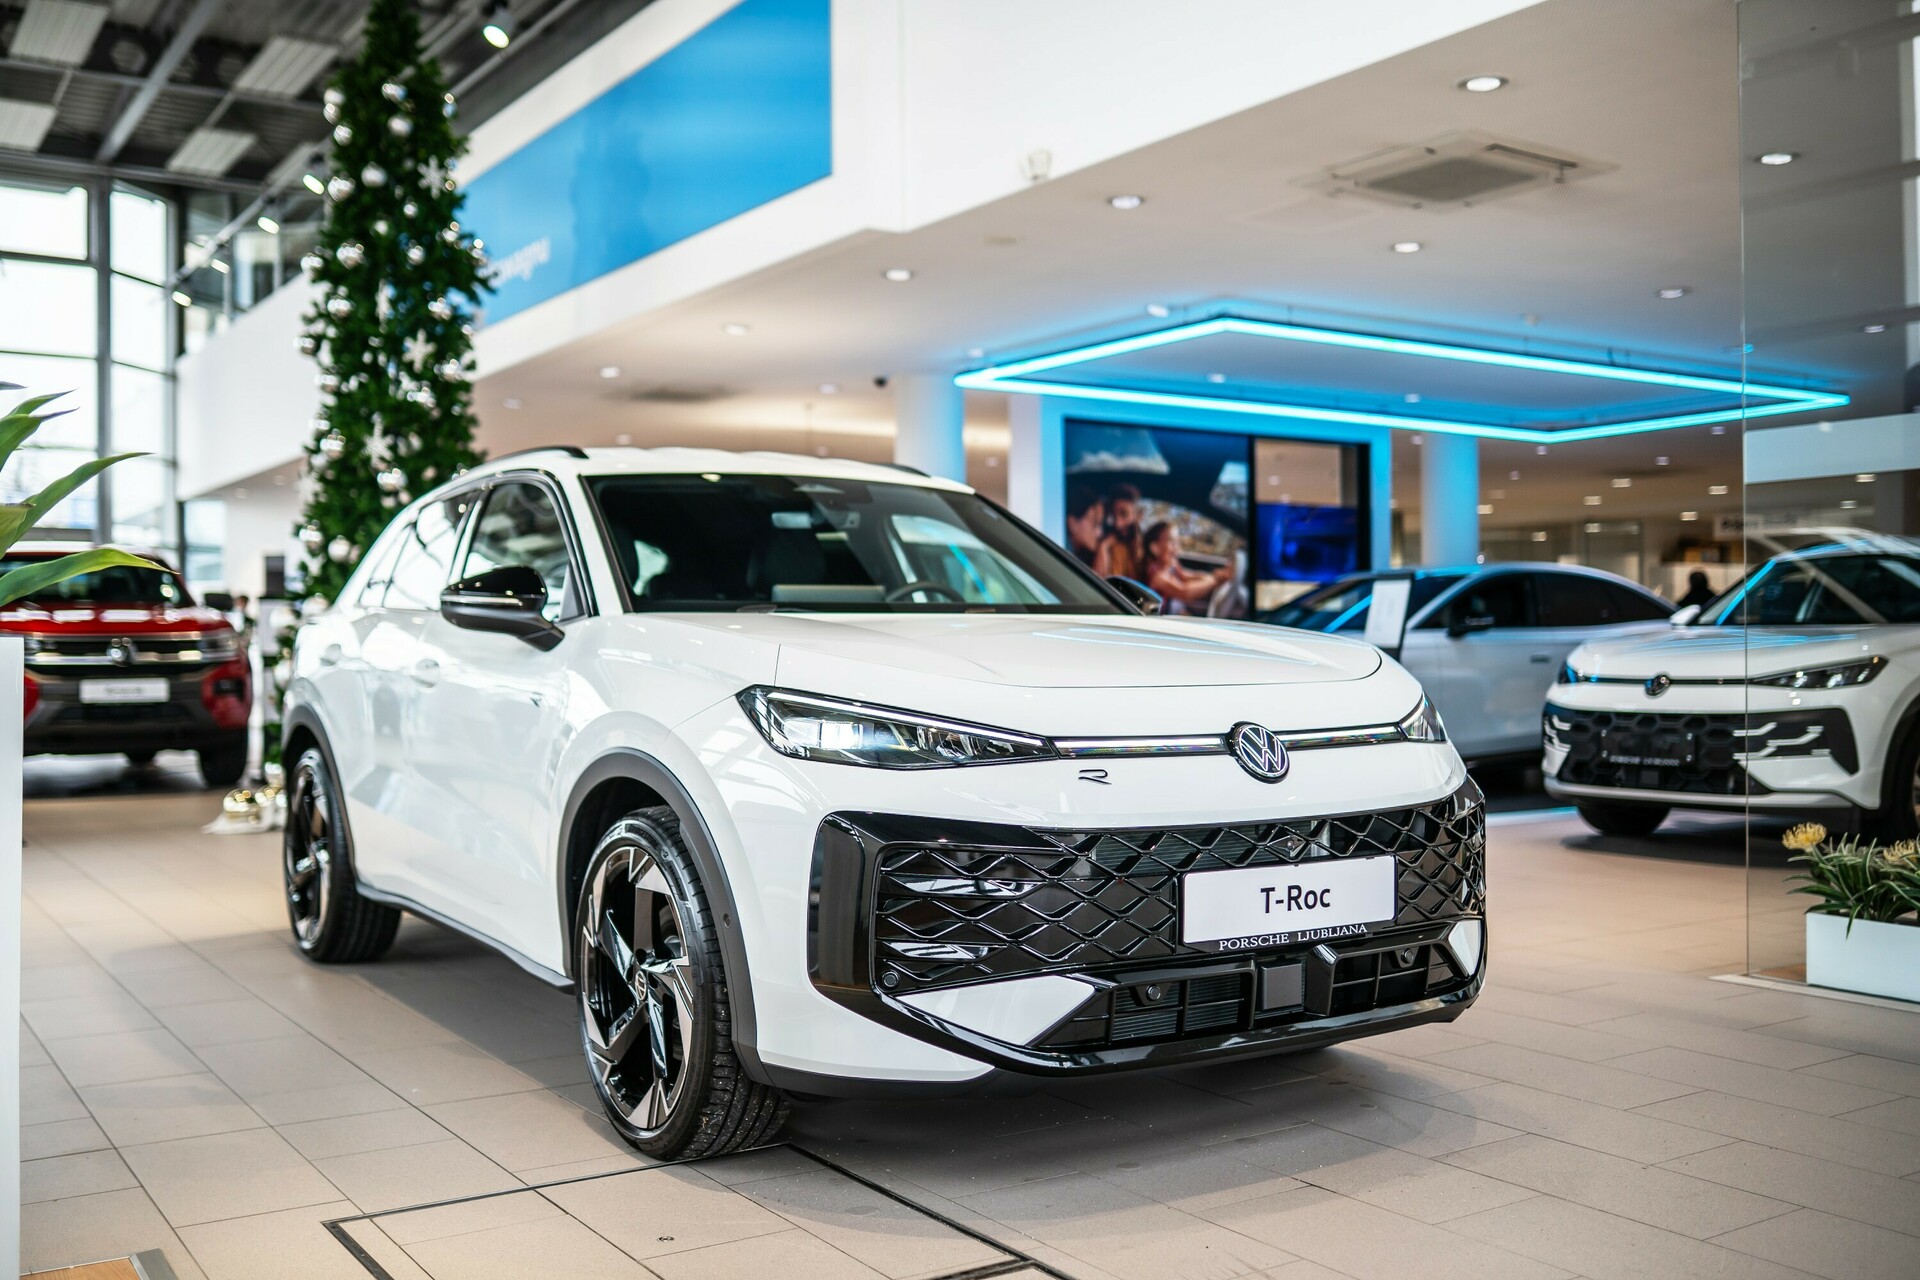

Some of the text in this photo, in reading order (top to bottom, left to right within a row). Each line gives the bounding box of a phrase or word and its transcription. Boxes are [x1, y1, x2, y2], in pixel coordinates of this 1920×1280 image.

[1260, 884, 1331, 914] T-Roc
[1218, 923, 1368, 951] PORSCHE LJUBLJANA
